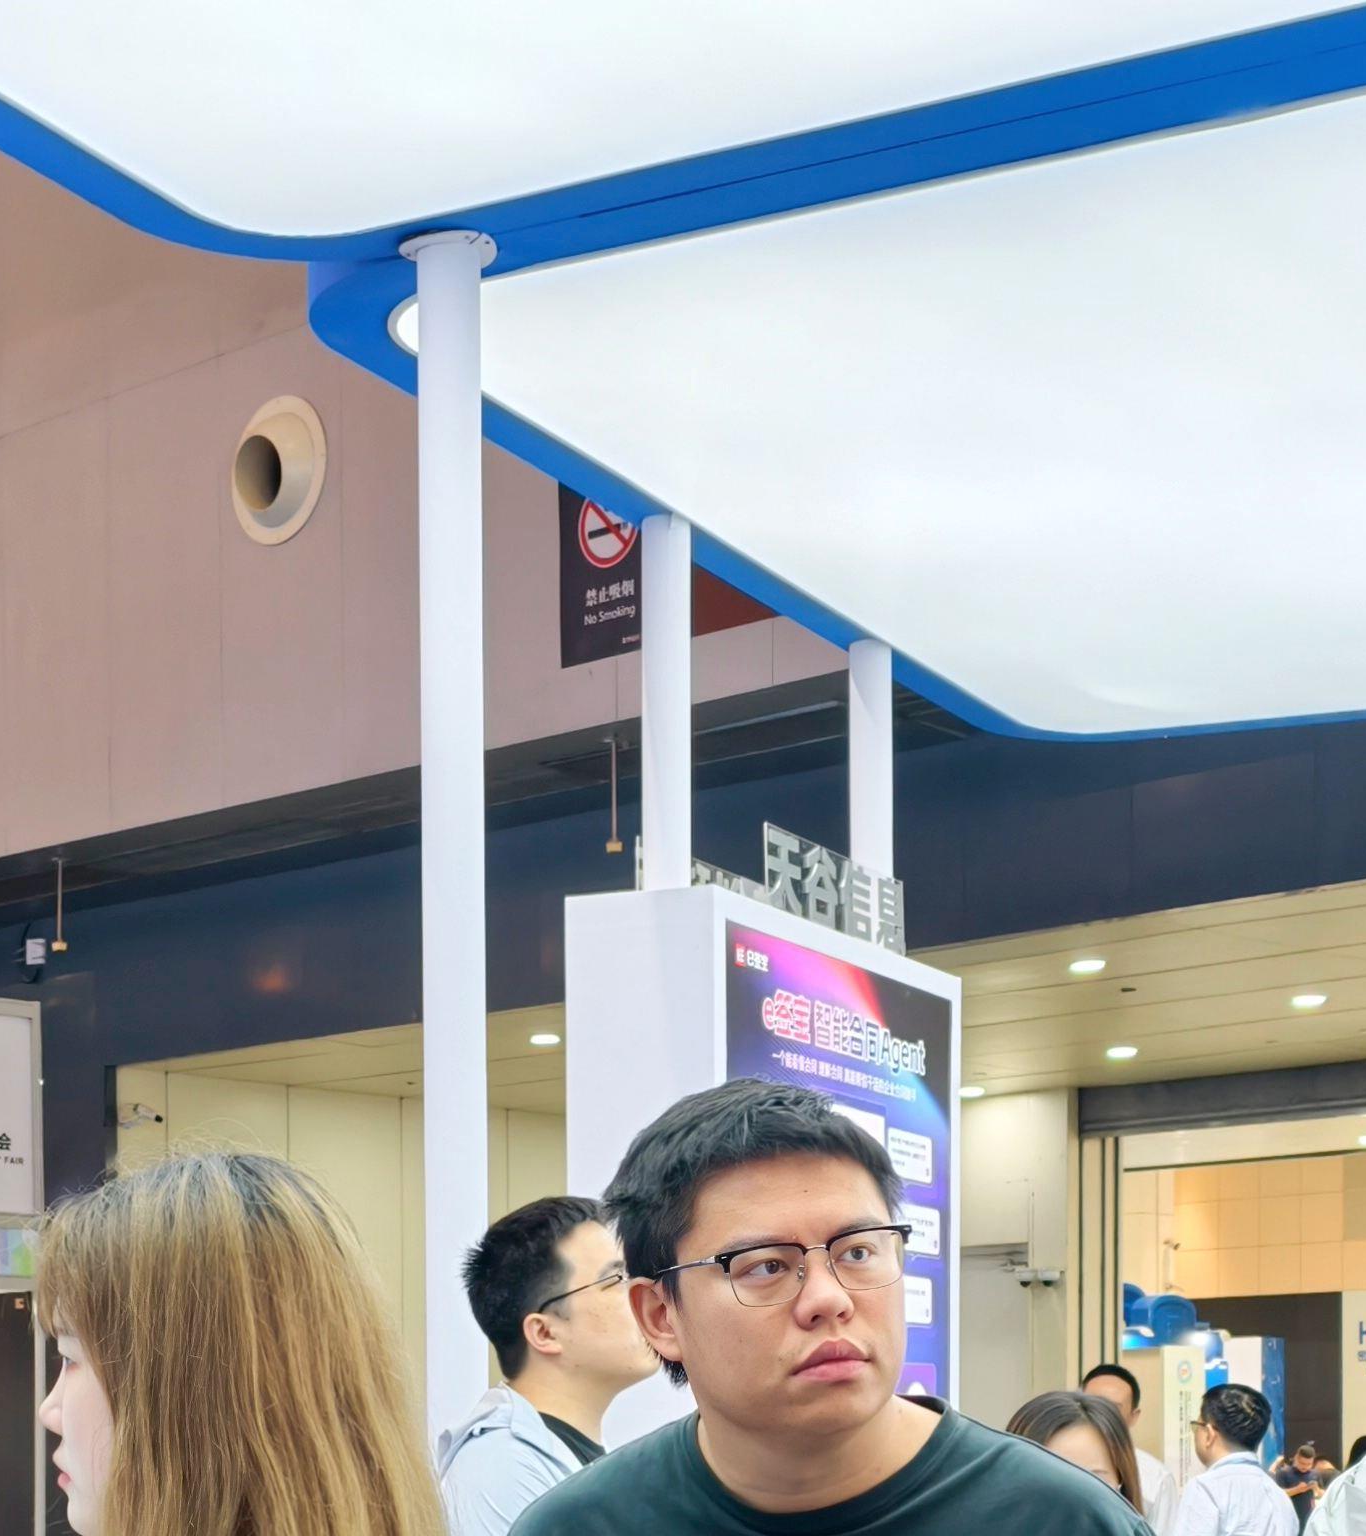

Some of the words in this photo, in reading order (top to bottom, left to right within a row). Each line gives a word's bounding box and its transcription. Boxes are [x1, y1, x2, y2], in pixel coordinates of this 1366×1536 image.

[586, 579, 635, 607] 禁止吸烟
[584, 613, 598, 626] No
[598, 605, 636, 623] Smoking
[766, 826, 906, 957] 天谷信息
[3, 1156, 25, 1166] FAIR
